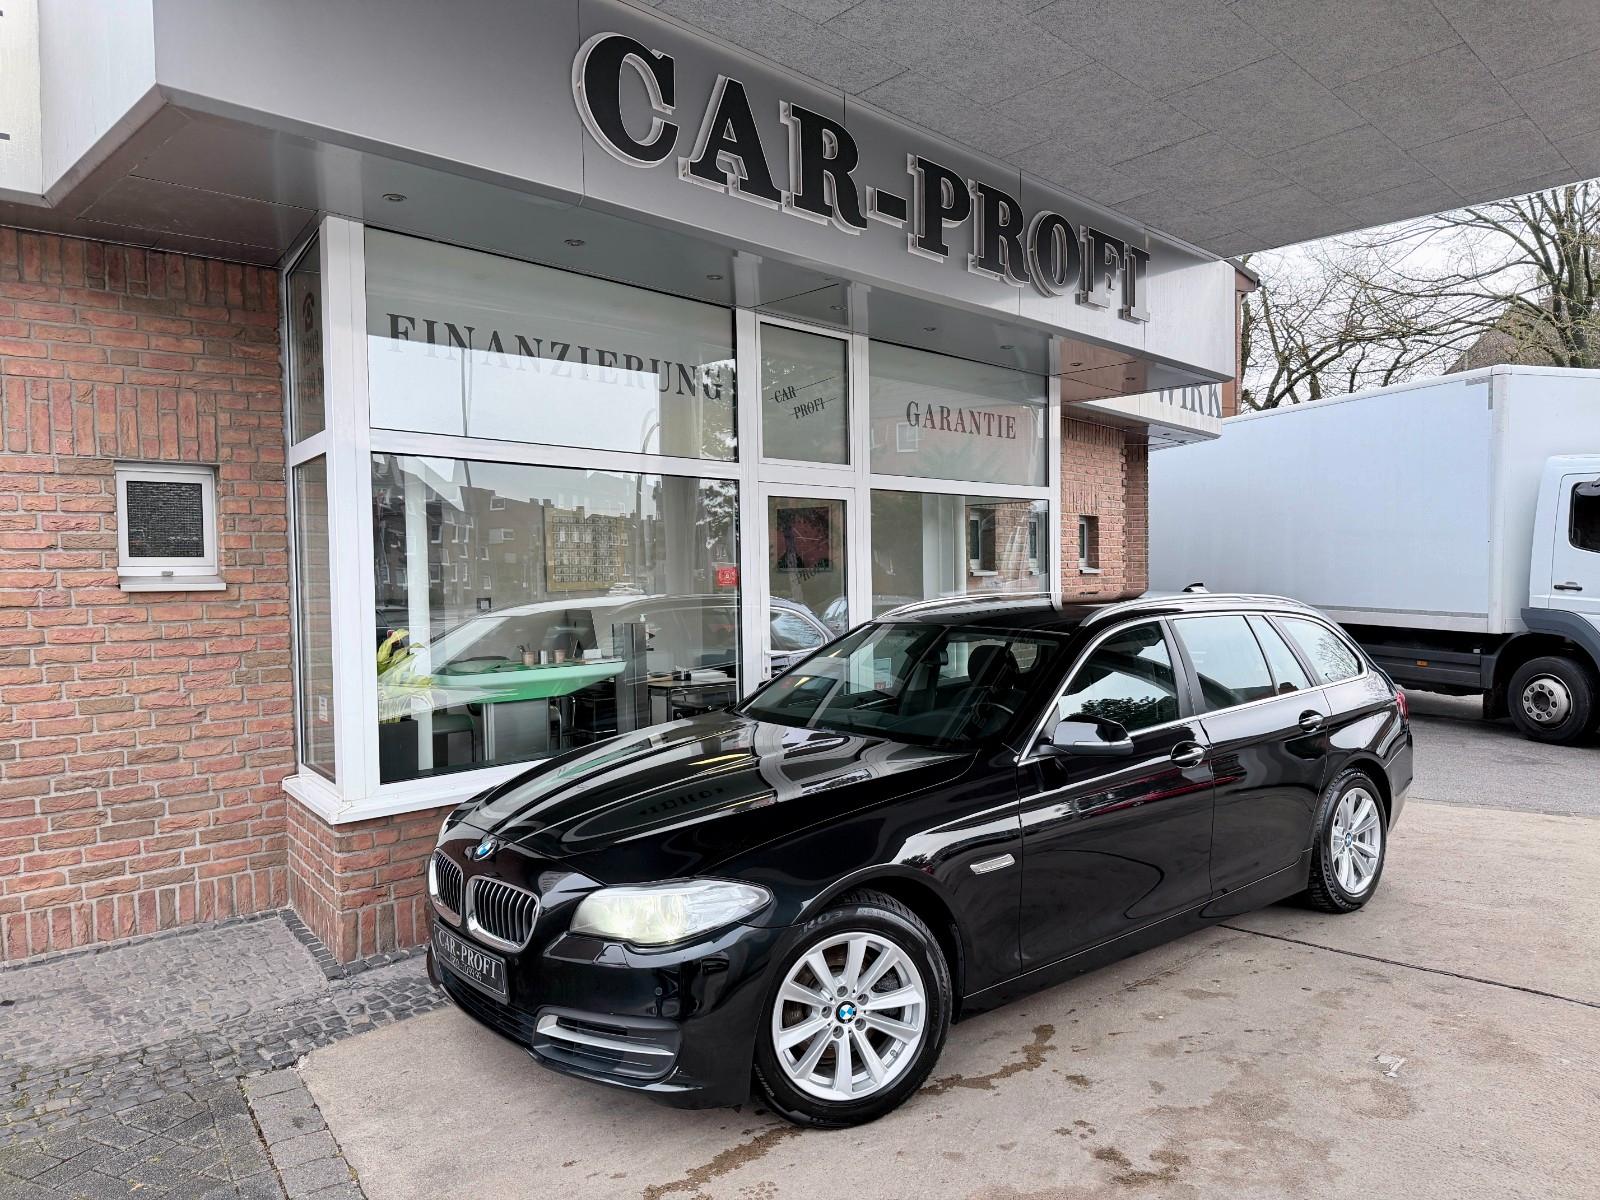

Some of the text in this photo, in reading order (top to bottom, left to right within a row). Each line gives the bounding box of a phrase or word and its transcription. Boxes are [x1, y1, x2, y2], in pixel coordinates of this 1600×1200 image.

[572, 32, 1150, 323] CAR-PROFI
[386, 313, 722, 400] FINANZIERUNG
[774, 385, 797, 404] CAR
[793, 397, 825, 419] PROFI
[906, 400, 1016, 440] GARANTIE
[438, 930, 496, 979] CAR-PROFI
